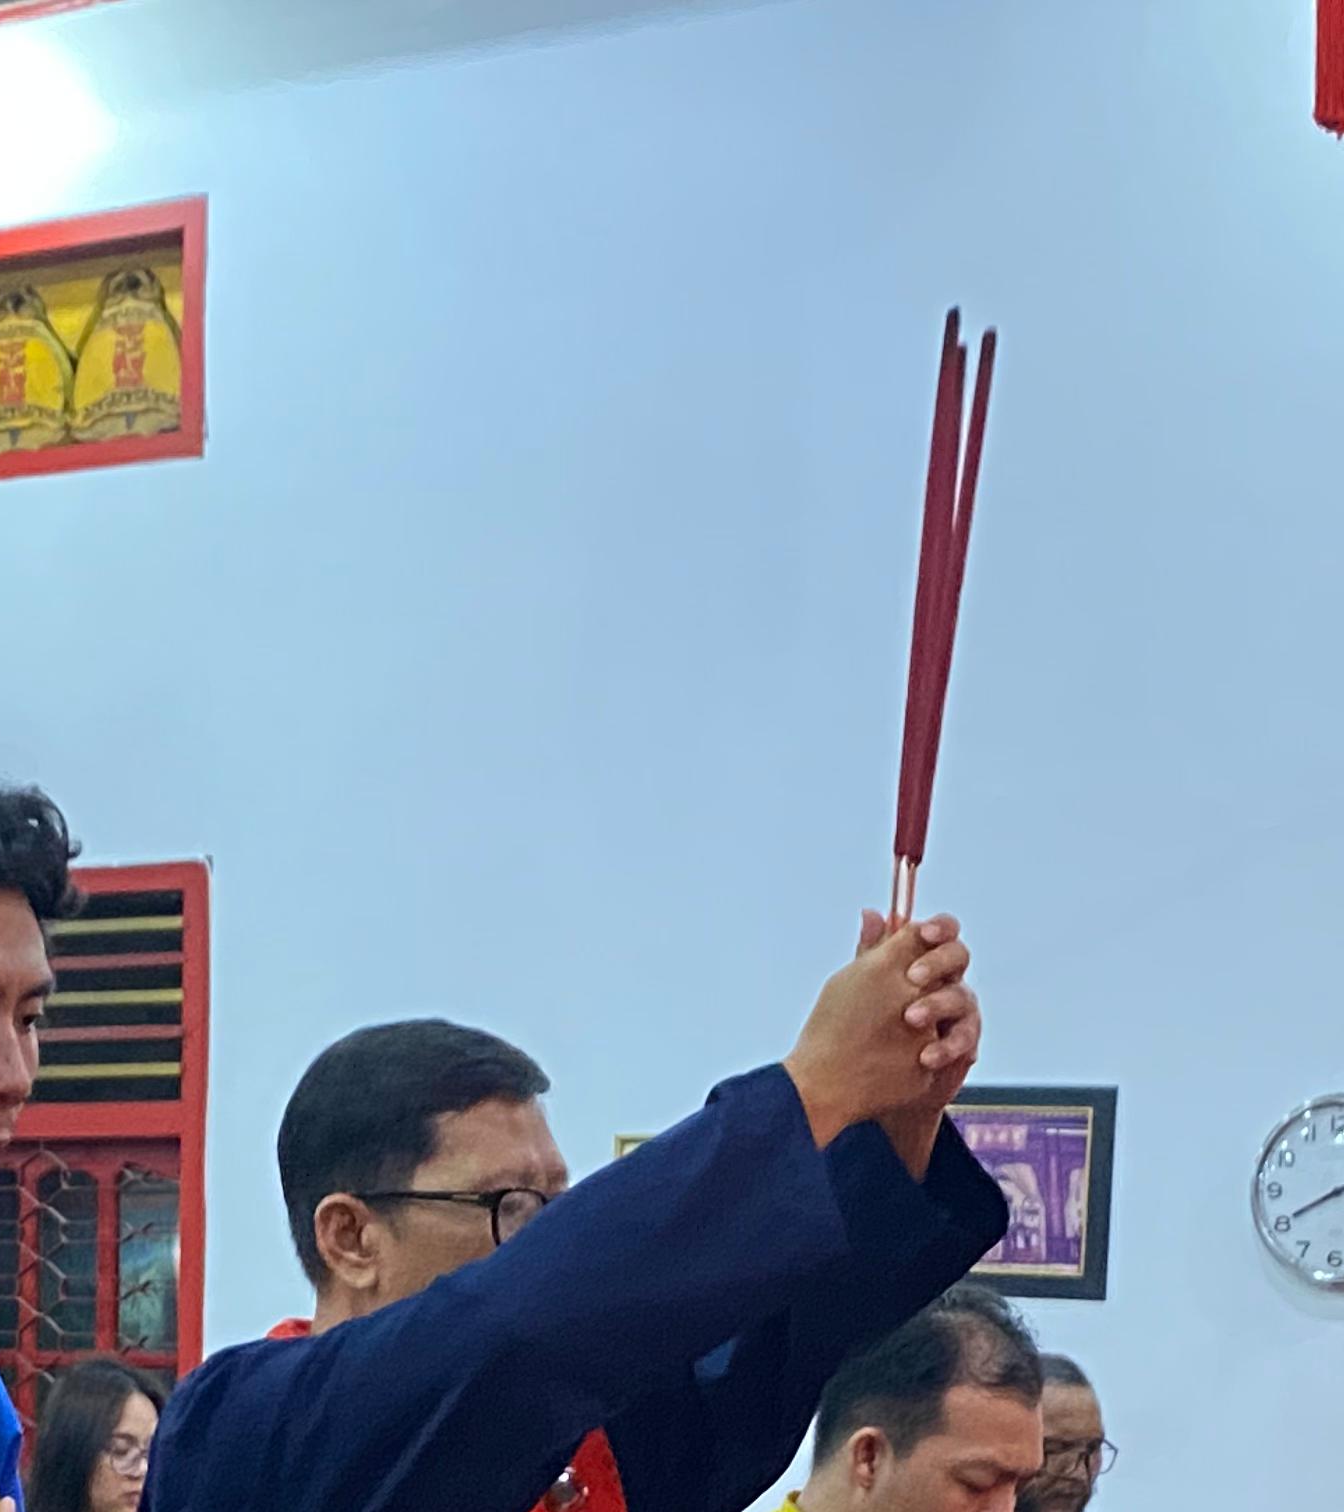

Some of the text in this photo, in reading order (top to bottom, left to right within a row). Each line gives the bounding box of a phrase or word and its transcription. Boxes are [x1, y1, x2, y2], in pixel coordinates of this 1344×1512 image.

[1304, 1124, 1316, 1142] 11
[1278, 1150, 1295, 1168] 10
[1267, 1182, 1283, 1200] 9
[1274, 1215, 1291, 1233] 8
[1296, 1240, 1310, 1258] 7
[1327, 1250, 1342, 1268] 6
